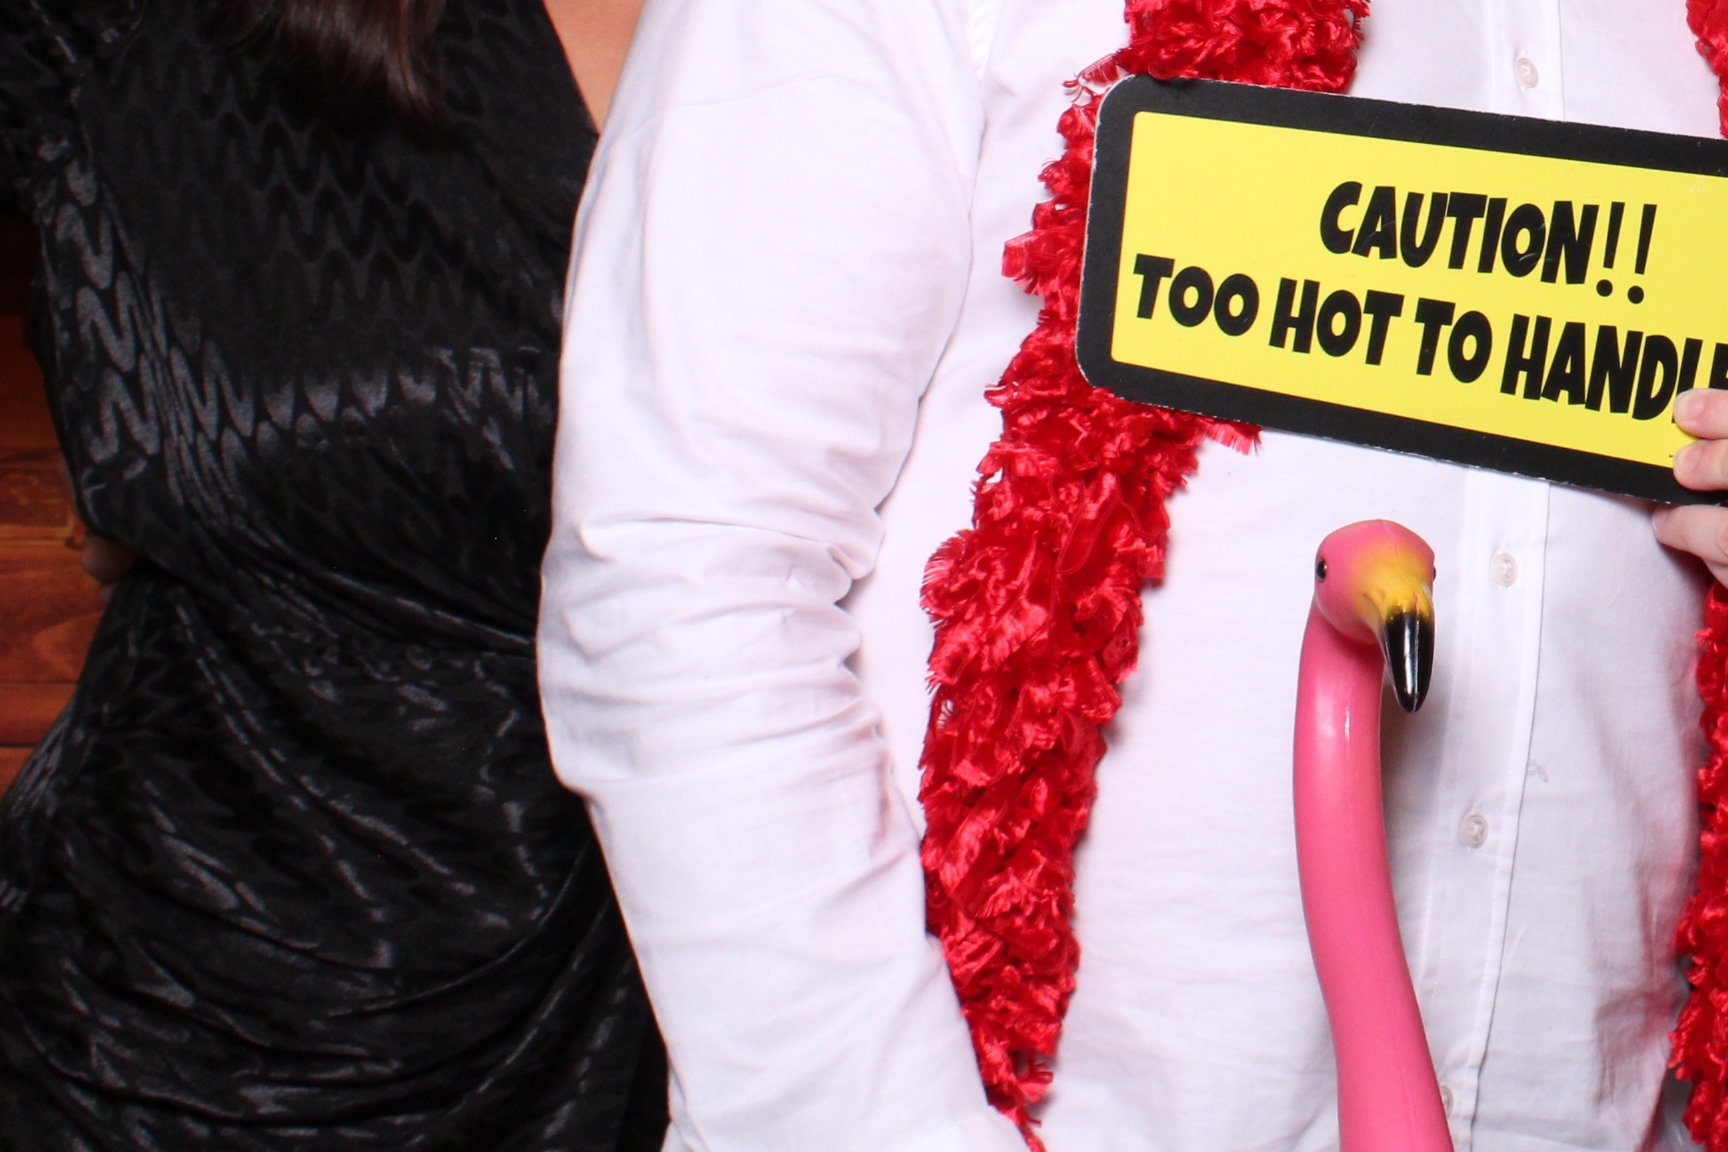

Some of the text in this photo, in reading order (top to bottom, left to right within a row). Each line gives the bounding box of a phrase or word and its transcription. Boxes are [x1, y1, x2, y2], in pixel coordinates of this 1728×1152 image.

[1320, 181, 1657, 305] CAUTION!!
[1133, 253, 1259, 337] TOO
[1269, 277, 1405, 366] HOT
[1414, 297, 1493, 384] TO
